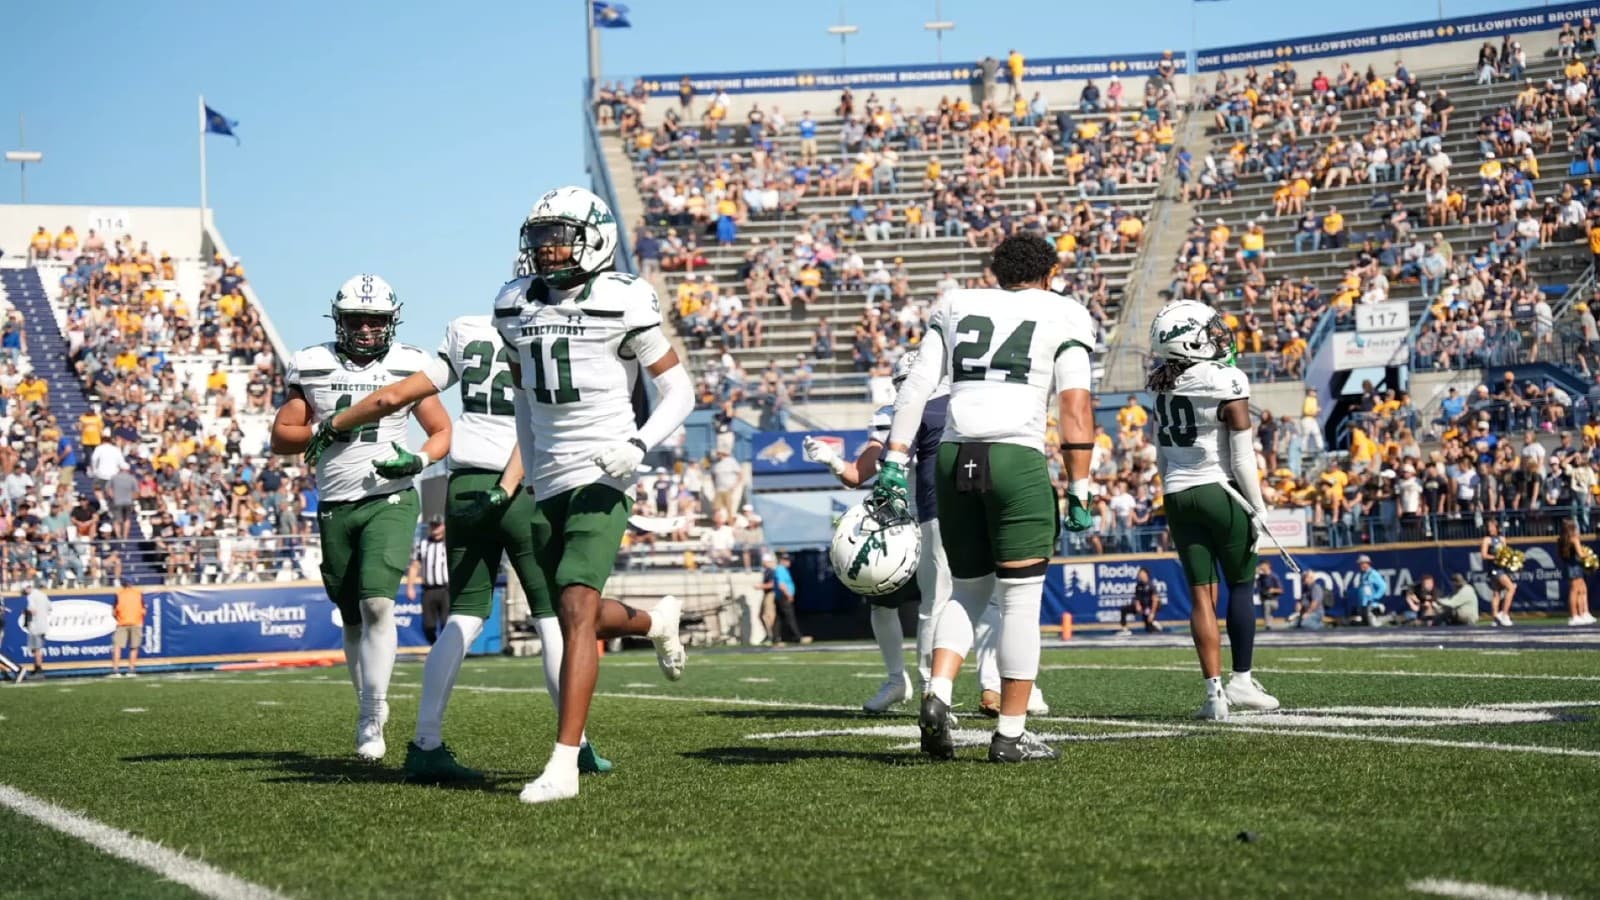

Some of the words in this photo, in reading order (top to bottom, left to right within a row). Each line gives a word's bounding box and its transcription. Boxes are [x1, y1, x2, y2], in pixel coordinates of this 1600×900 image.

[1457, 14, 1544, 34] YELLOWSTONE
[1294, 36, 1377, 54] YELLOWSTONE
[1380, 30, 1435, 46] BROKERS
[1223, 48, 1274, 64] BROKERS
[816, 72, 896, 85] YELLOWSTONE
[900, 69, 950, 82] BROKERS
[1055, 62, 1108, 75] BROKERS
[1367, 312, 1398, 327] 117
[522, 325, 586, 336] MERCYHURST
[952, 314, 1037, 385] 24
[530, 337, 581, 404] 11
[1155, 393, 1198, 447] 10
[48, 609, 106, 628] arrier
[179, 601, 306, 625] NorthWestern
[260, 619, 306, 638] Energy
[48, 646, 60, 657] to
[61, 644, 80, 656] the
